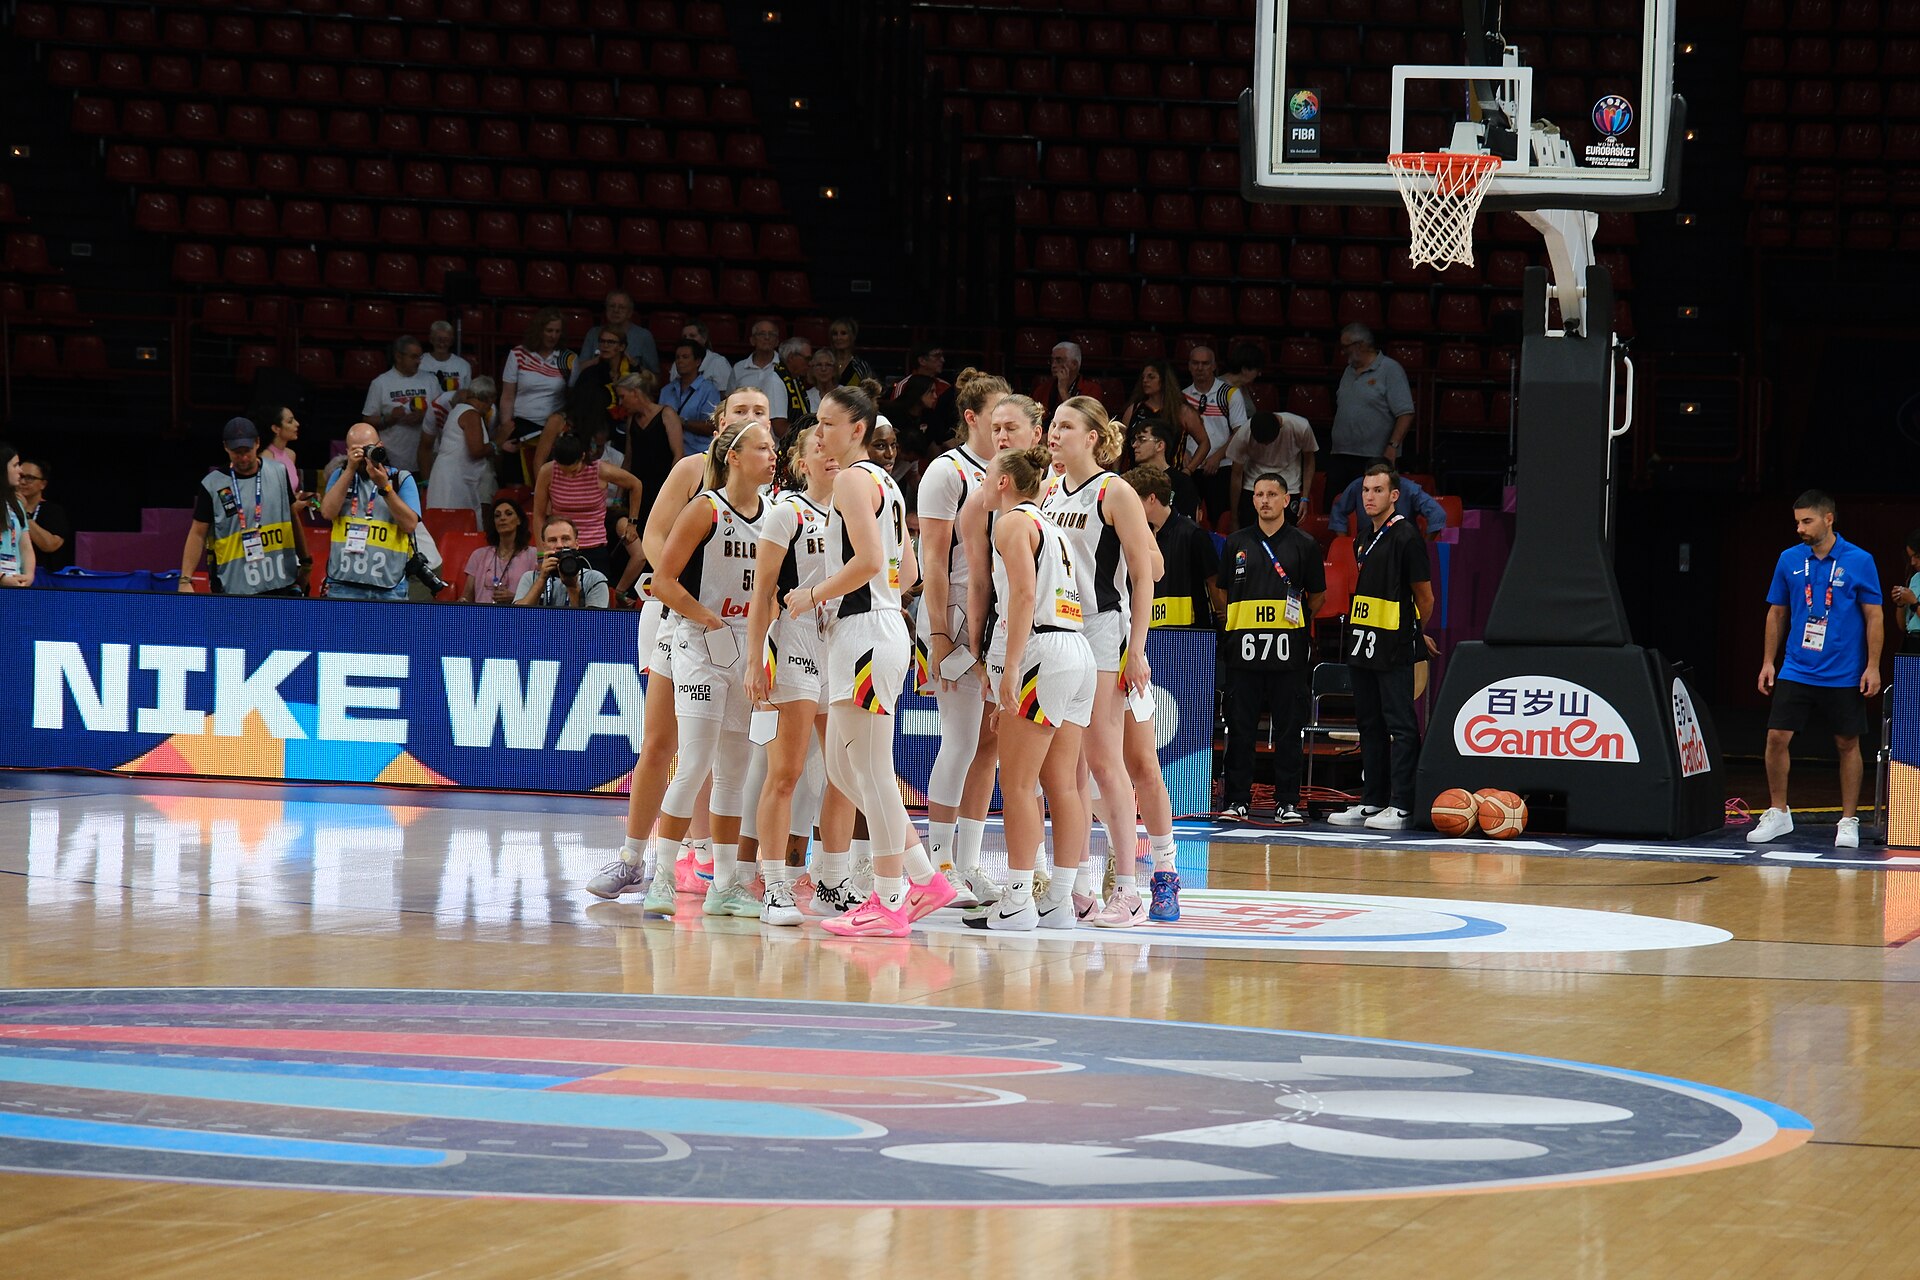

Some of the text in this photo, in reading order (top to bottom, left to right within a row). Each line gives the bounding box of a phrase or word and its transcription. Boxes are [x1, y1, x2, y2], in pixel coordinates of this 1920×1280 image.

[1292, 128, 1315, 140] FIBA
[1585, 145, 1636, 157] EUROBASKET
[390, 389, 426, 398] BELGIUM
[340, 547, 387, 578] 582
[1058, 535, 1072, 579] 4
[1256, 605, 1276, 623] HB
[1354, 601, 1369, 619] HB
[1241, 633, 1290, 661] 670
[1351, 629, 1377, 659] 73
[33, 640, 409, 744] NIKE
[678, 684, 711, 693] POWER
[690, 692, 711, 701] ADE
[1488, 688, 1589, 717] 百岁山
[1464, 714, 1624, 760] Ganten
